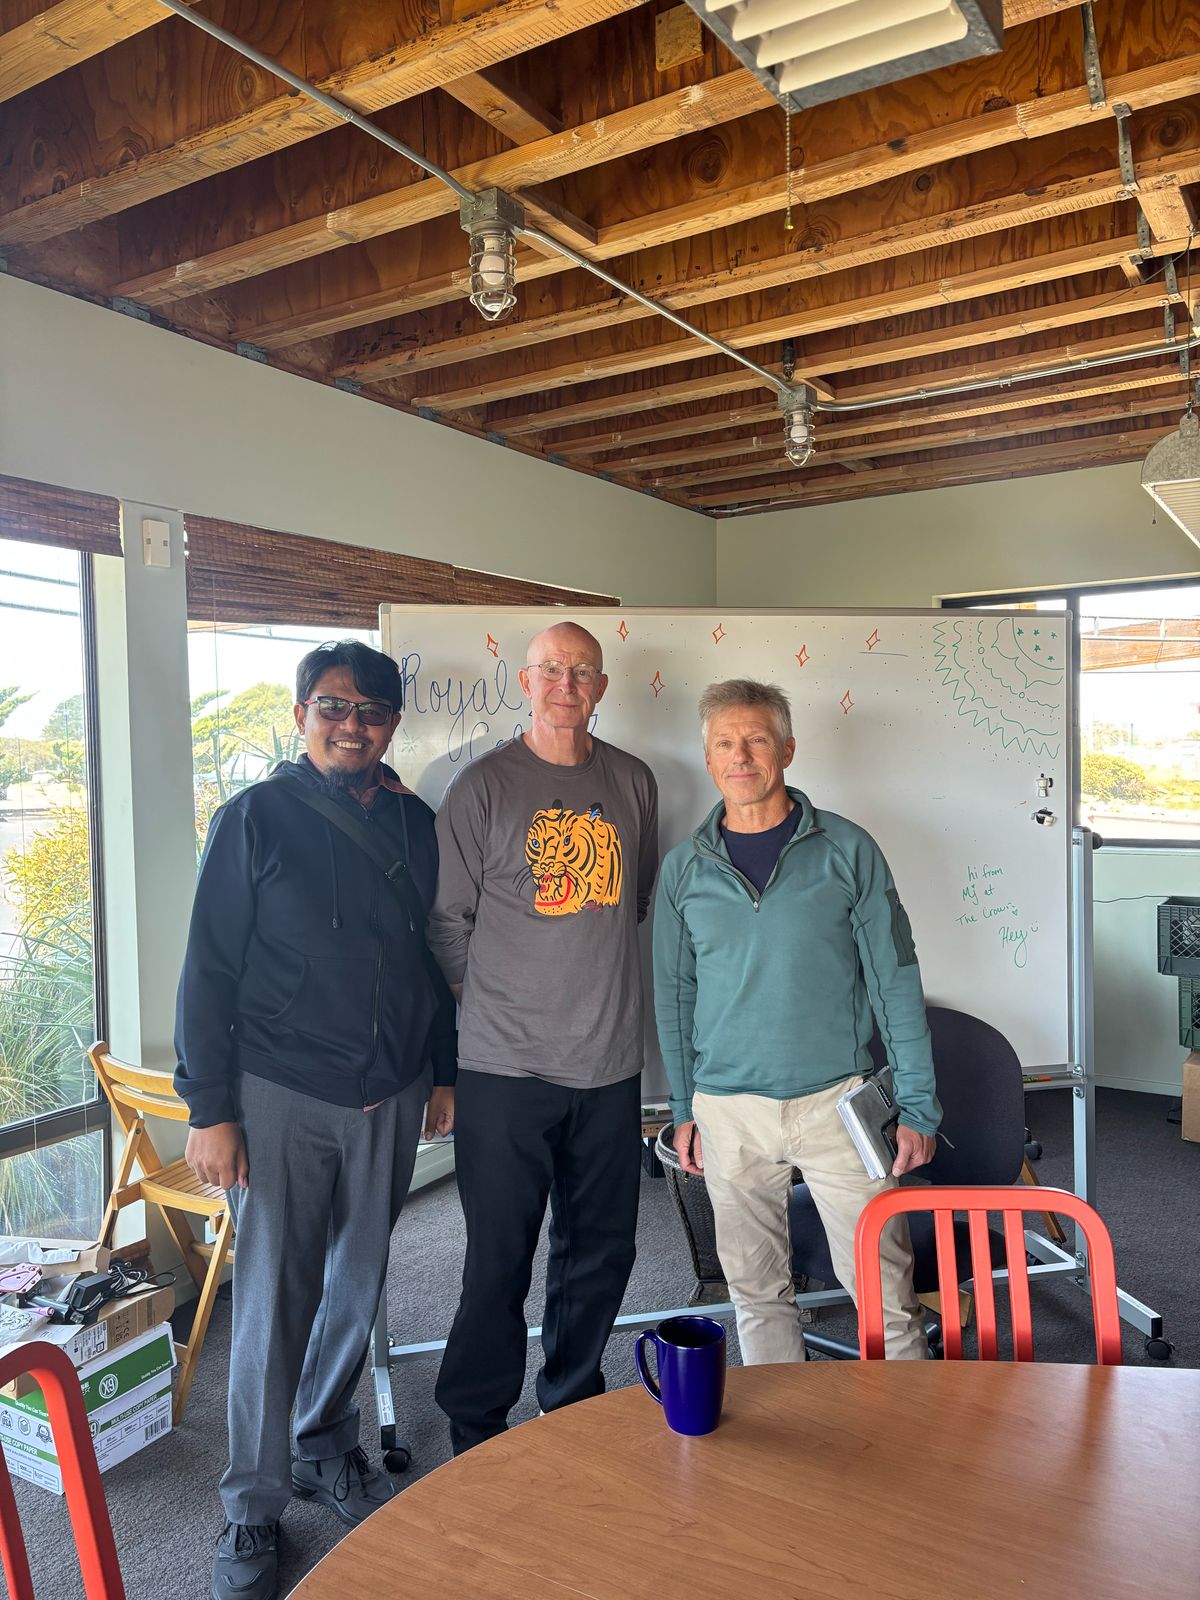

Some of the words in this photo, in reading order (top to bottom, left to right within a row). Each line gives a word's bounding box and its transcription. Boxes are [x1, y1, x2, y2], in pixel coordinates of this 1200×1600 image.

[399, 652, 522, 762] Royal
[967, 865, 978, 882] hi
[982, 863, 1003, 879] from
[984, 883, 995, 896] at
[955, 913, 977, 926] The
[998, 926, 1028, 968] Hey
